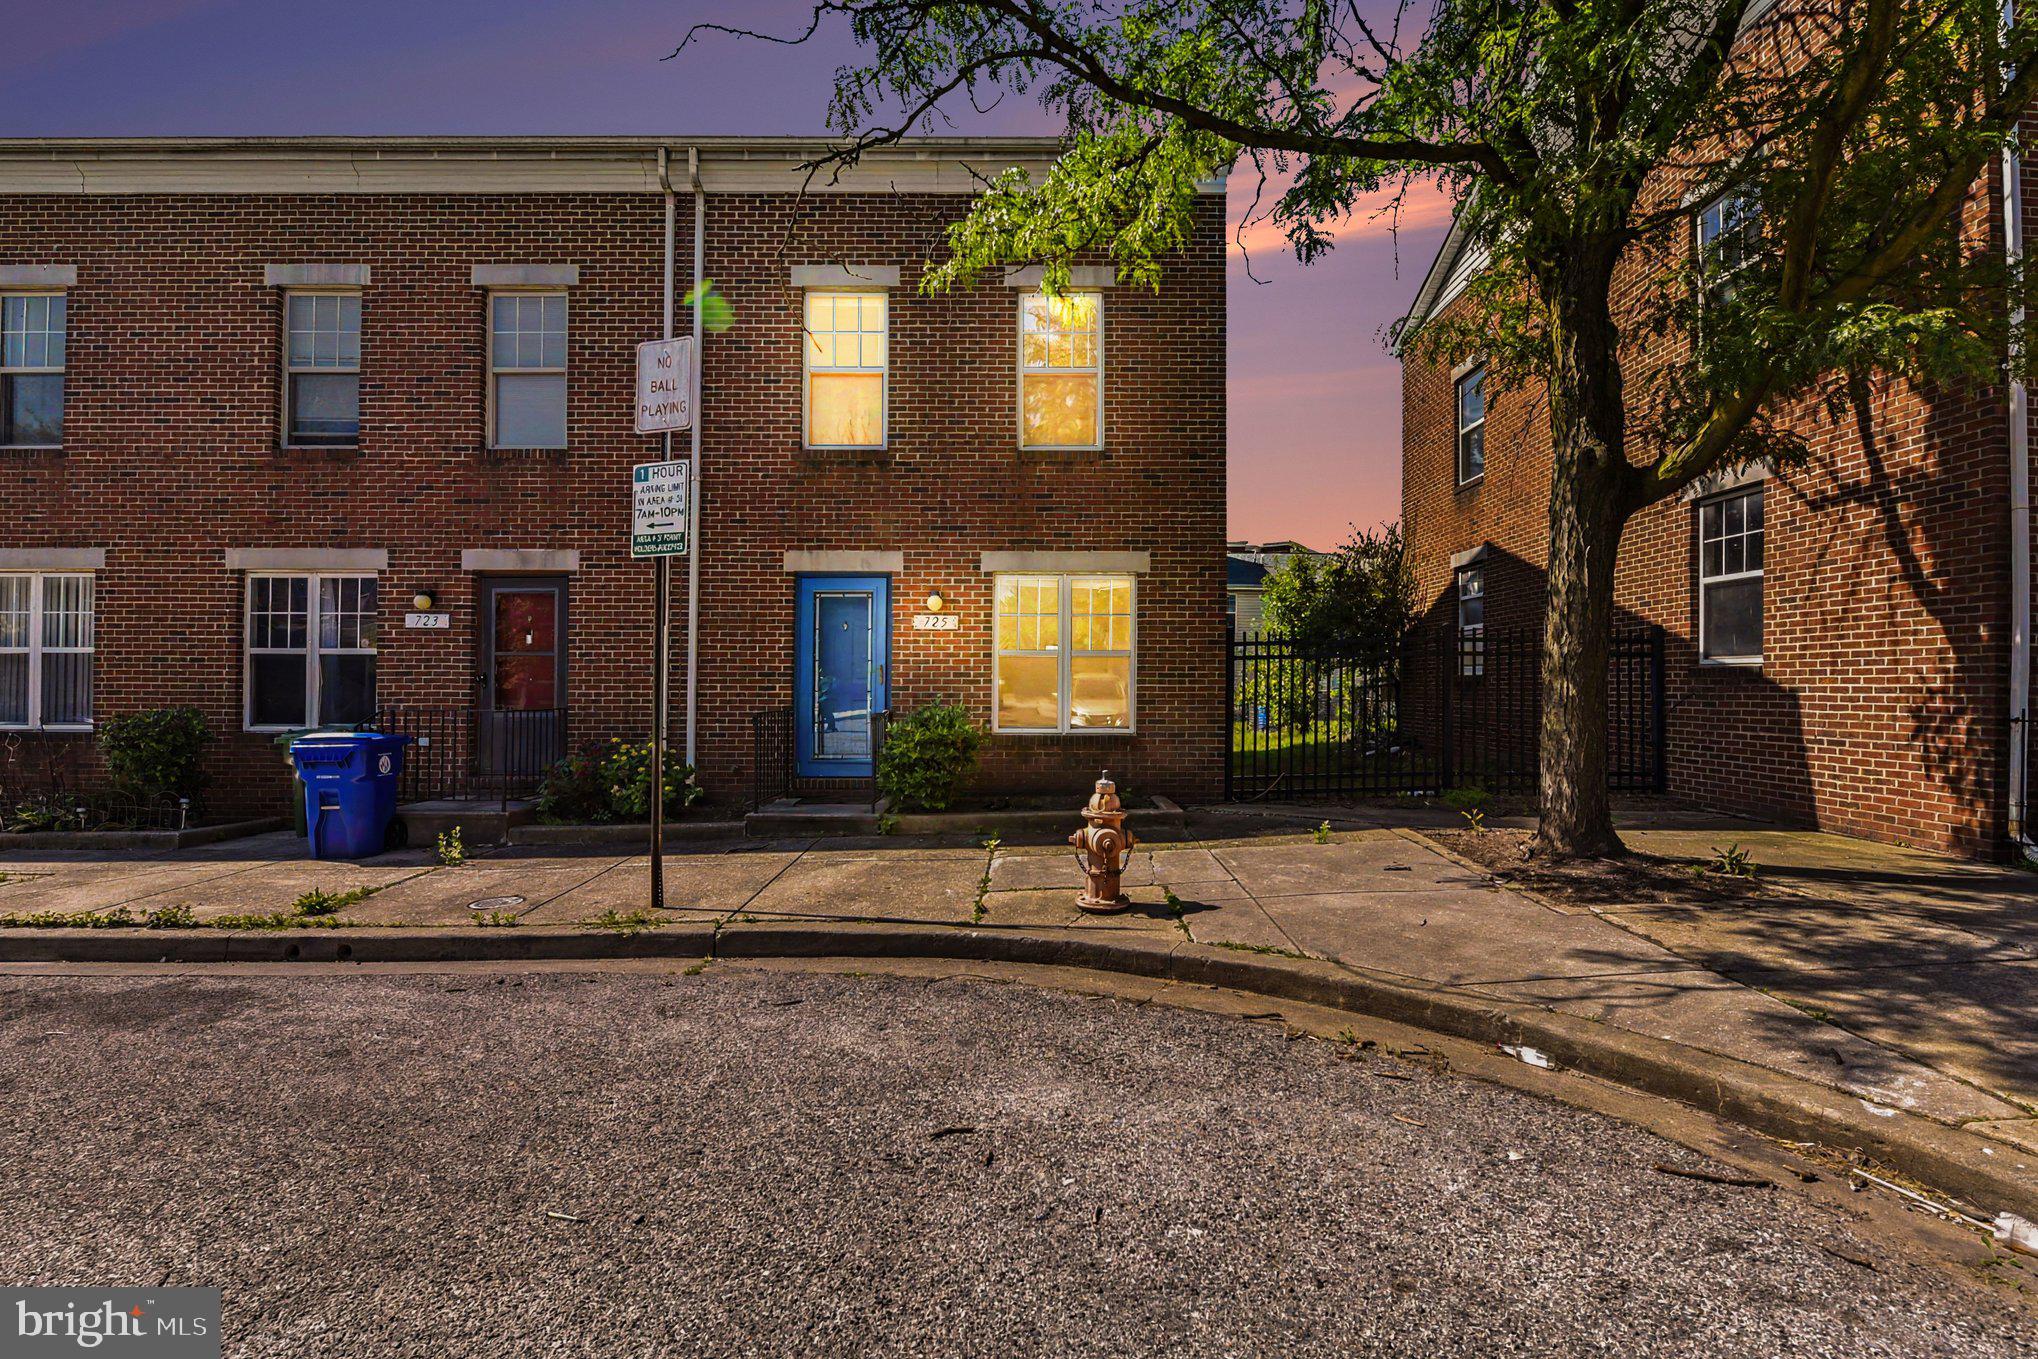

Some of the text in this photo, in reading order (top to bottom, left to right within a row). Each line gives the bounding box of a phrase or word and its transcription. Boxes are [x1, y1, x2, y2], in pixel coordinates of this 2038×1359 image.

[657, 355, 672, 369] NO
[650, 379, 678, 393] BALL
[641, 400, 687, 417] PLAYING
[652, 465, 684, 479] HOUR
[637, 484, 666, 495] ARKING
[635, 507, 684, 519] 7AM-10PM
[415, 615, 439, 626] 723
[924, 616, 948, 627] 725
